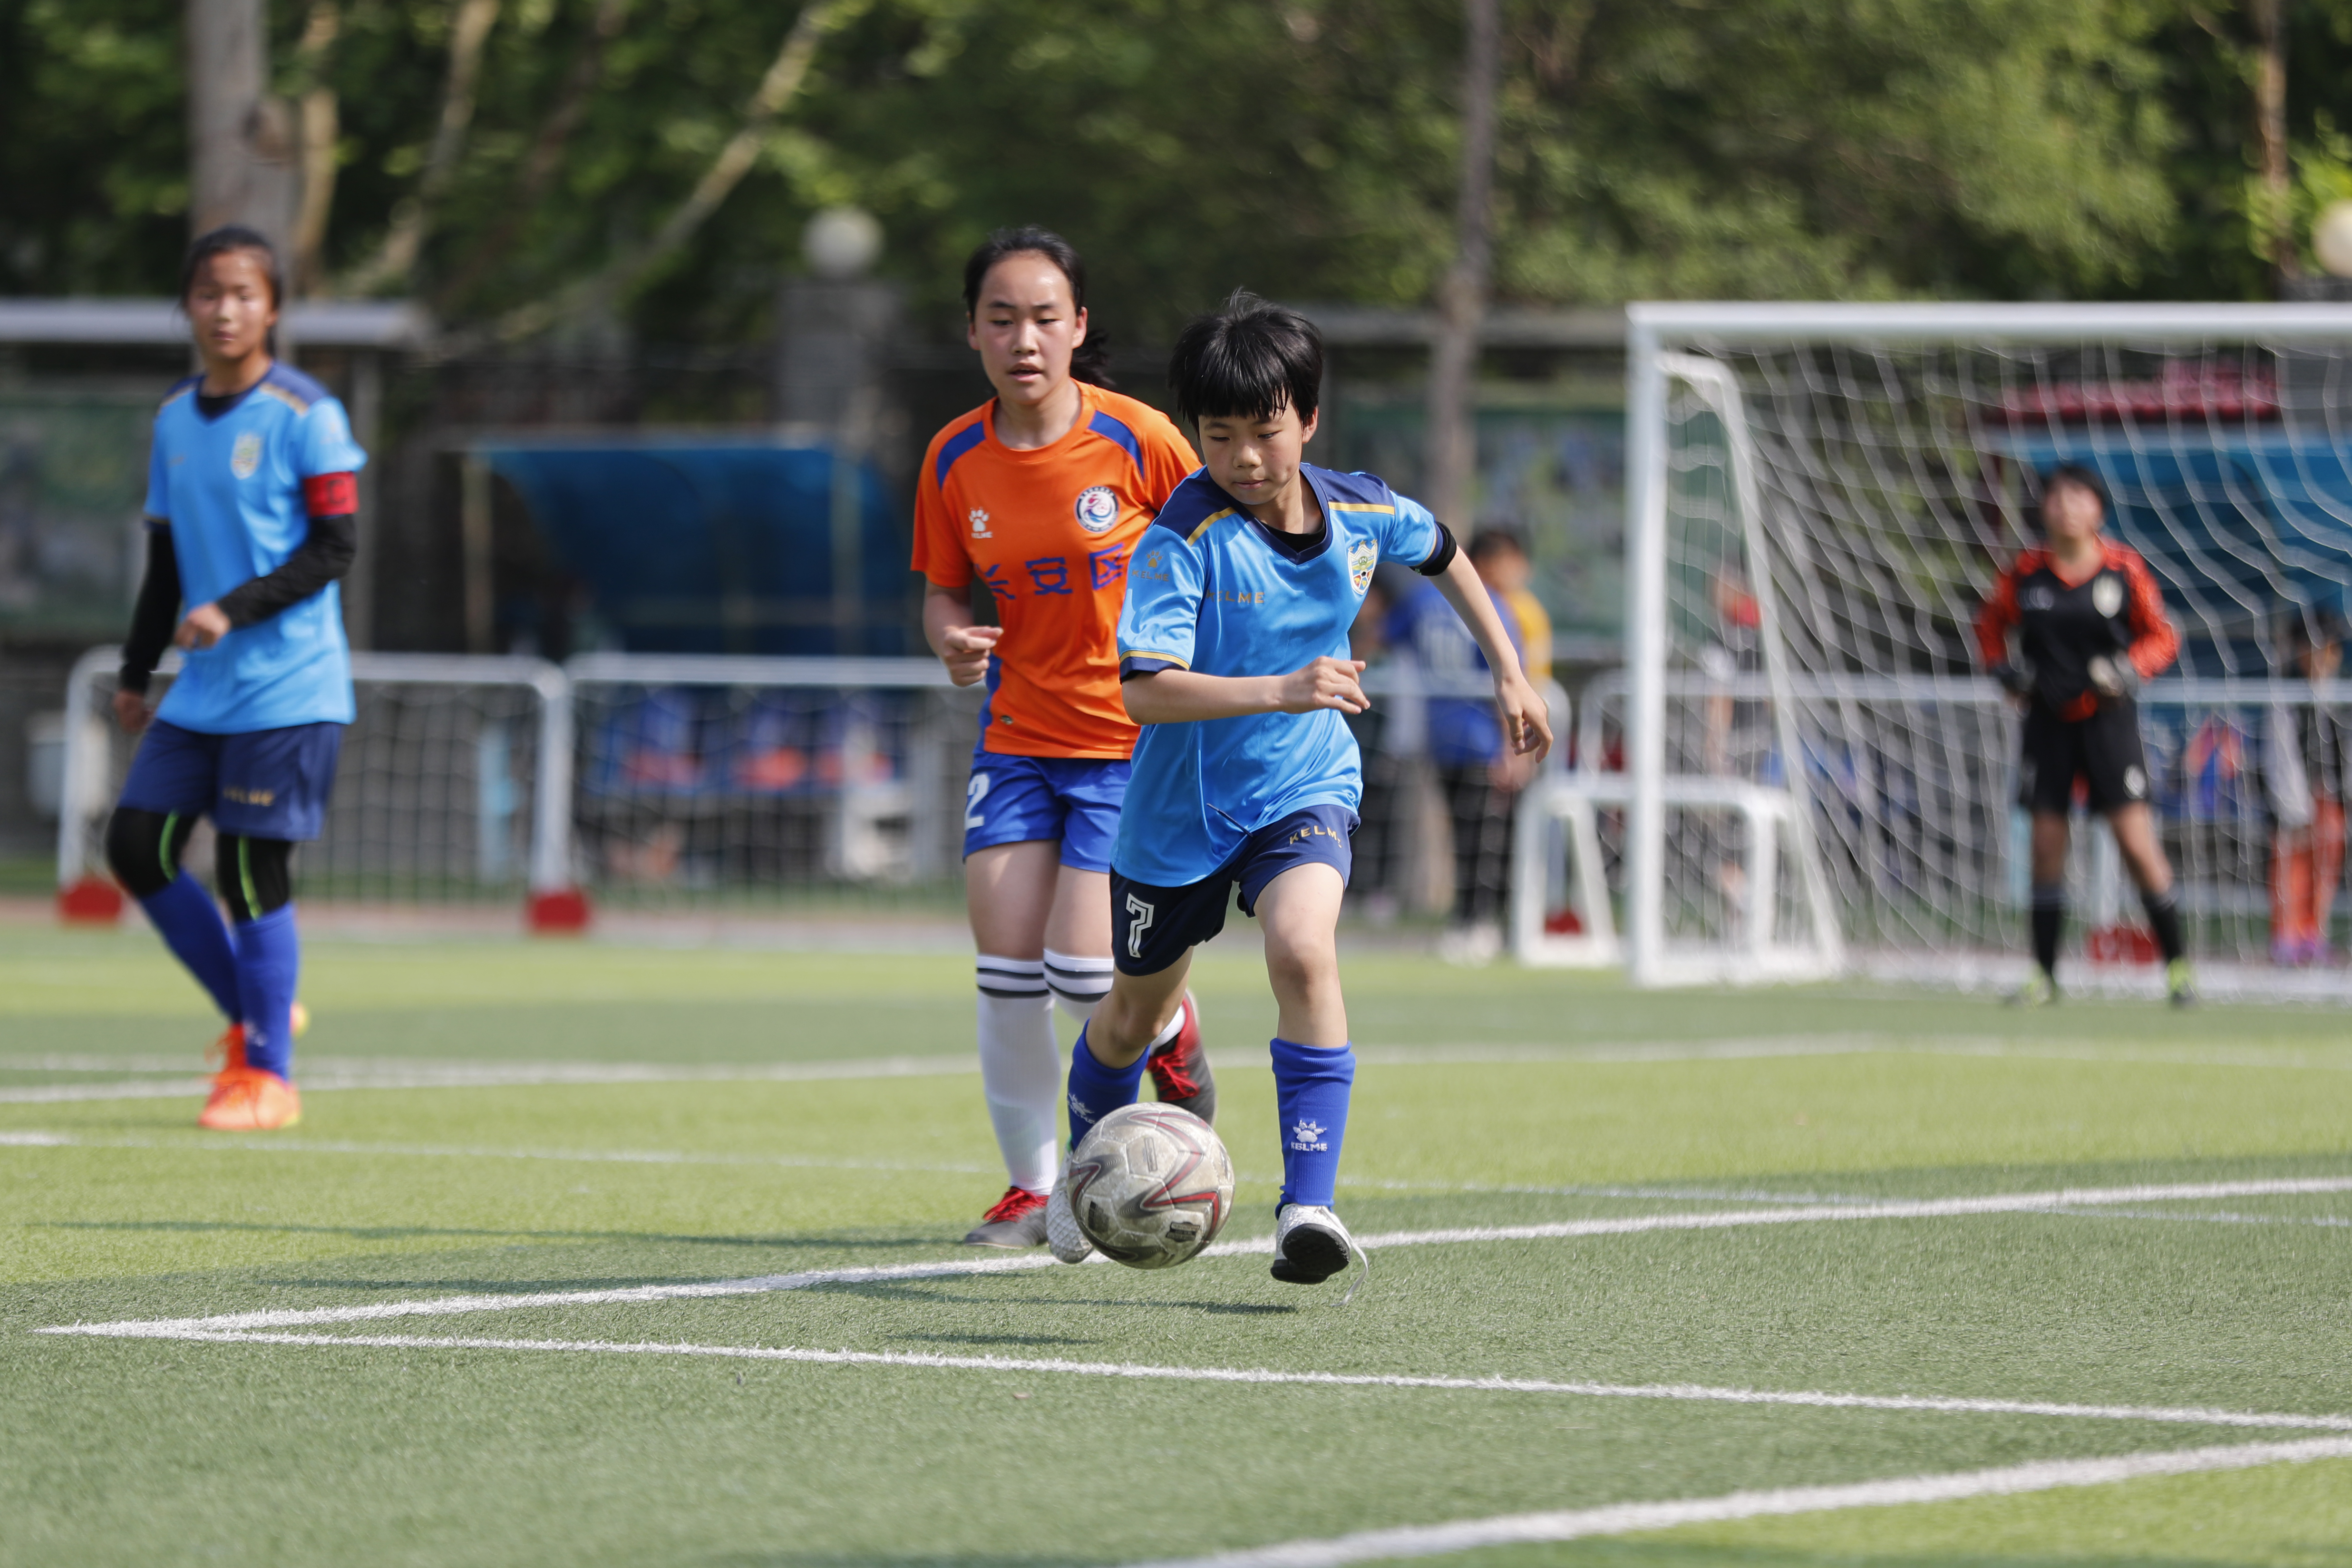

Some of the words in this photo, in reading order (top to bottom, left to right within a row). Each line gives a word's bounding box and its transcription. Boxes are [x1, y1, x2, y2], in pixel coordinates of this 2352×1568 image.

[1131, 569, 1169, 582] KELME
[1205, 589, 1264, 604] KELME
[964, 773, 990, 830] 2
[1289, 825, 1342, 848] KELME
[1126, 893, 1154, 958] 7
[1291, 1141, 1328, 1152] KELME
